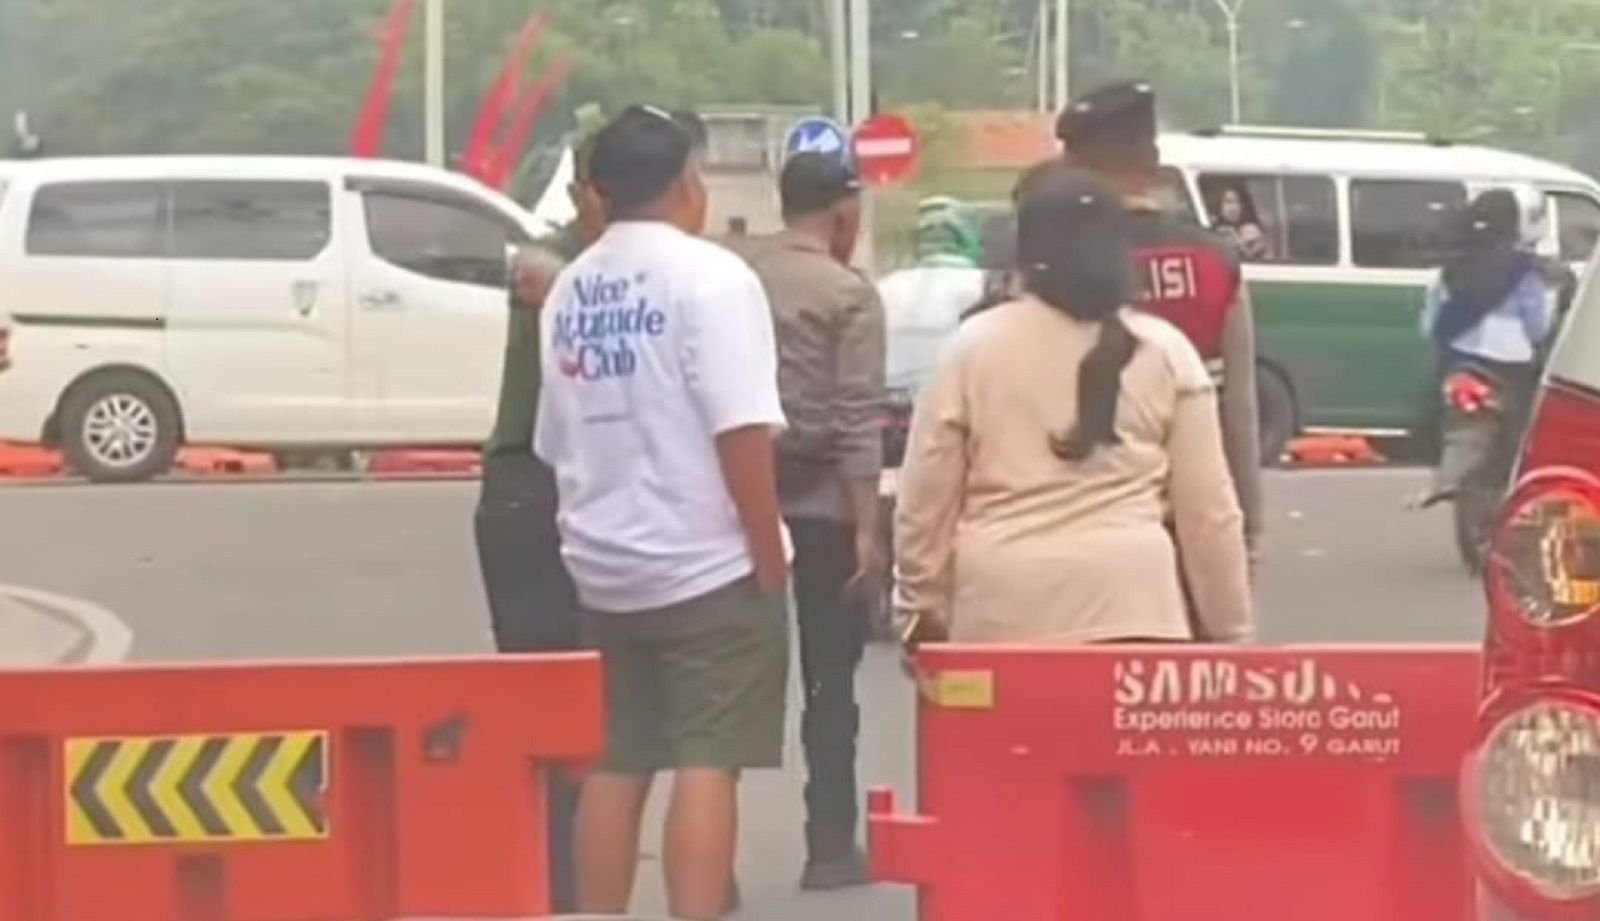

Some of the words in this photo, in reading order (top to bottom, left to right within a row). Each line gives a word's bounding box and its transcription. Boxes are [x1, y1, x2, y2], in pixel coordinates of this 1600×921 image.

[573, 273, 629, 308] Nice
[577, 337, 637, 381] Club
[1299, 734, 1317, 754] 9
[1326, 739, 1399, 756] GARUT
